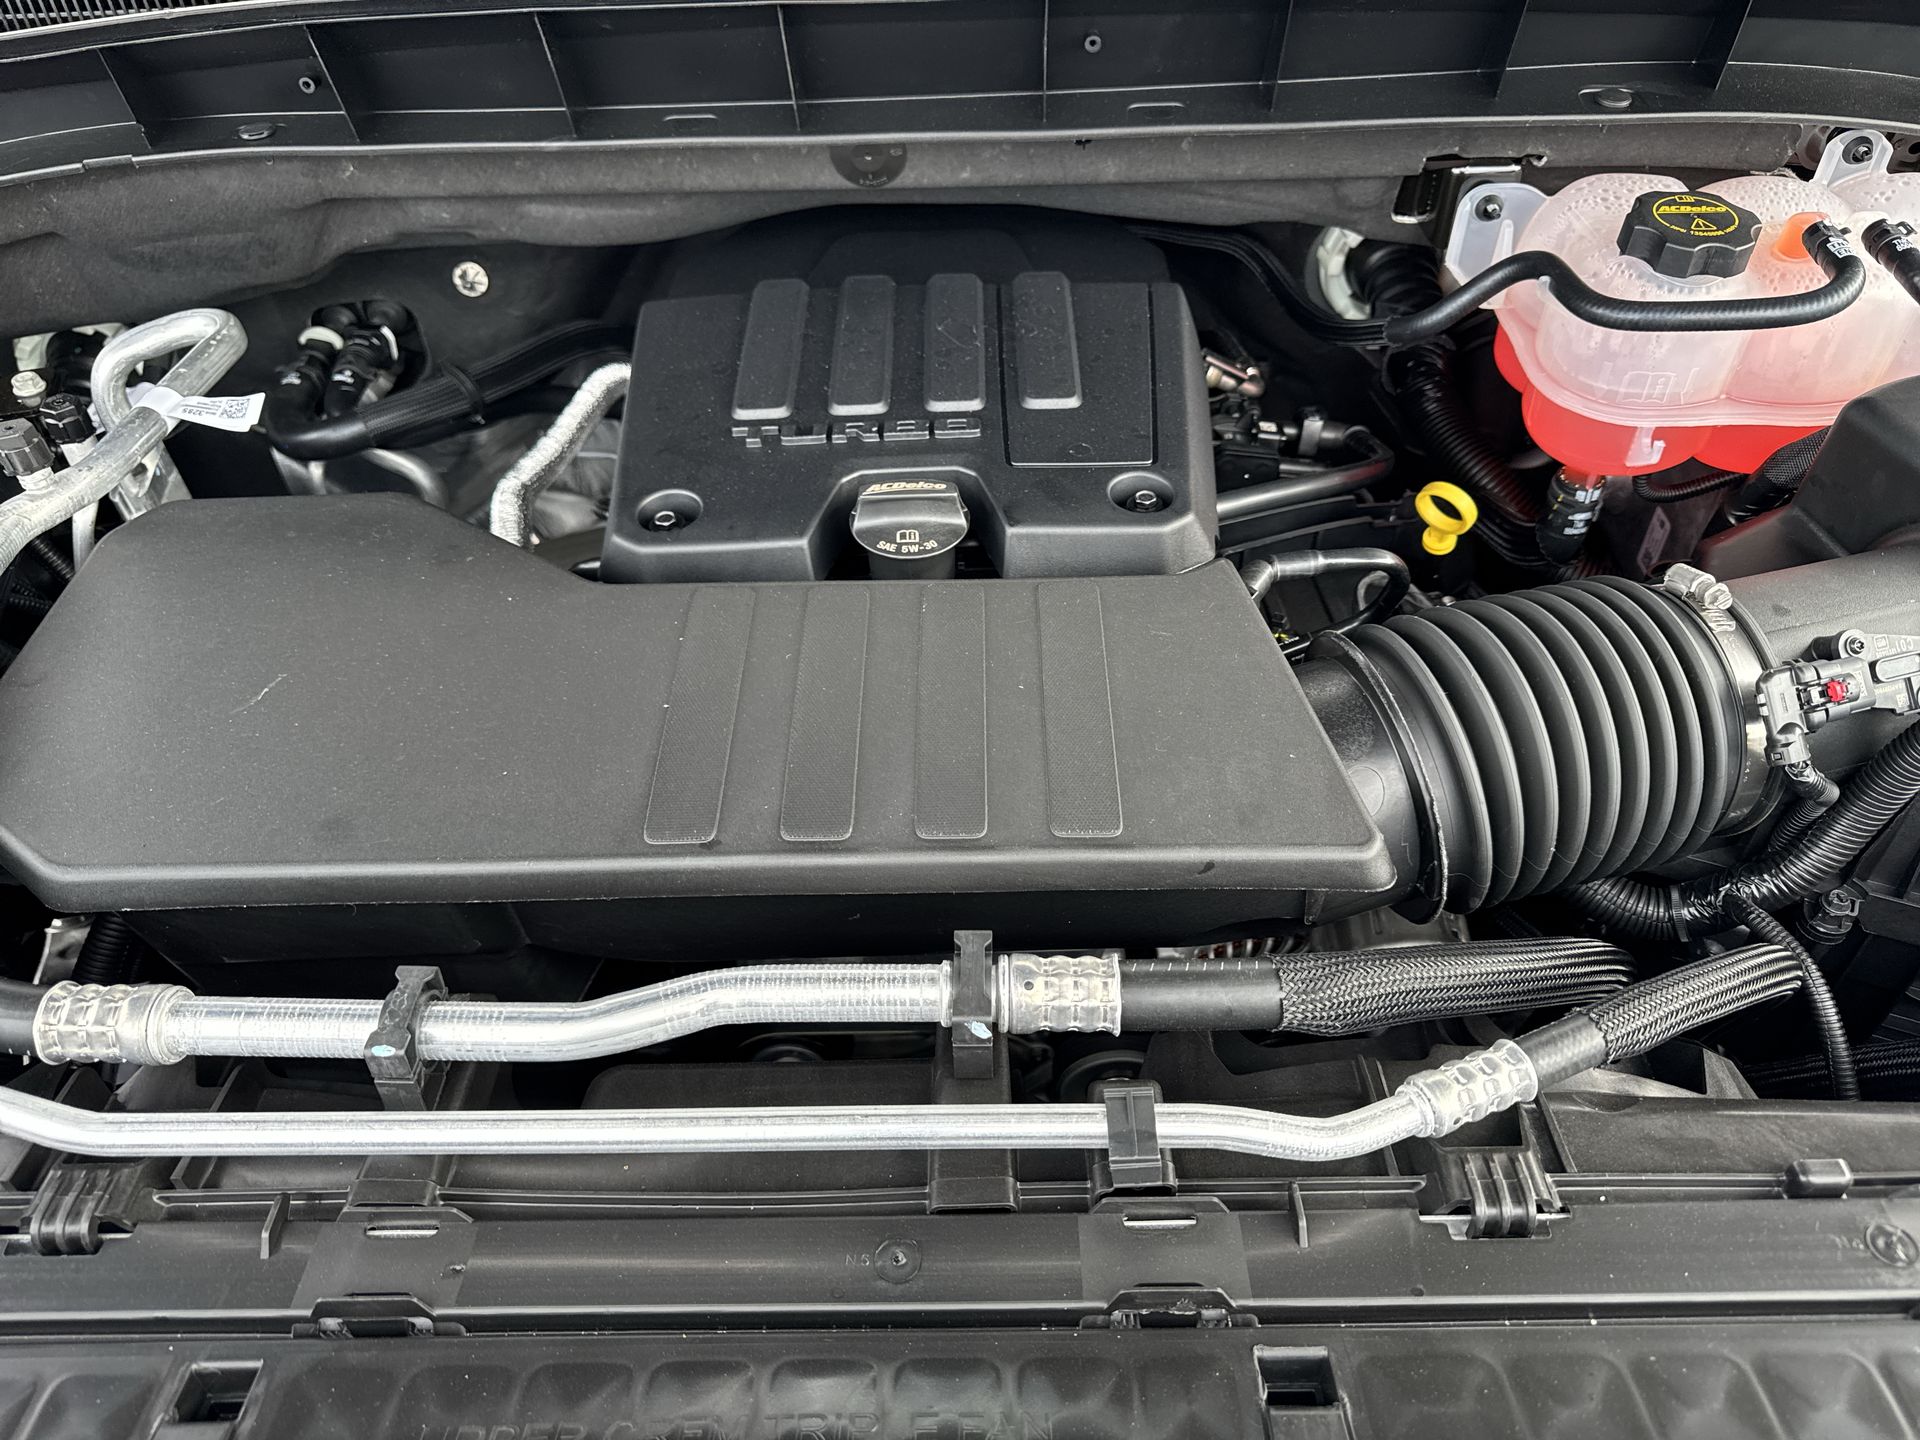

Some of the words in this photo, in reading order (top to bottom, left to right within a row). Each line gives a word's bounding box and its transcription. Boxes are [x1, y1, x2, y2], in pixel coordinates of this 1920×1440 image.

[1657, 205, 1728, 213] ACDelco
[731, 418, 982, 448] TURBO
[863, 481, 947, 494] ACDelco
[876, 540, 898, 552] SAE
[901, 539, 938, 553] 5W-30
